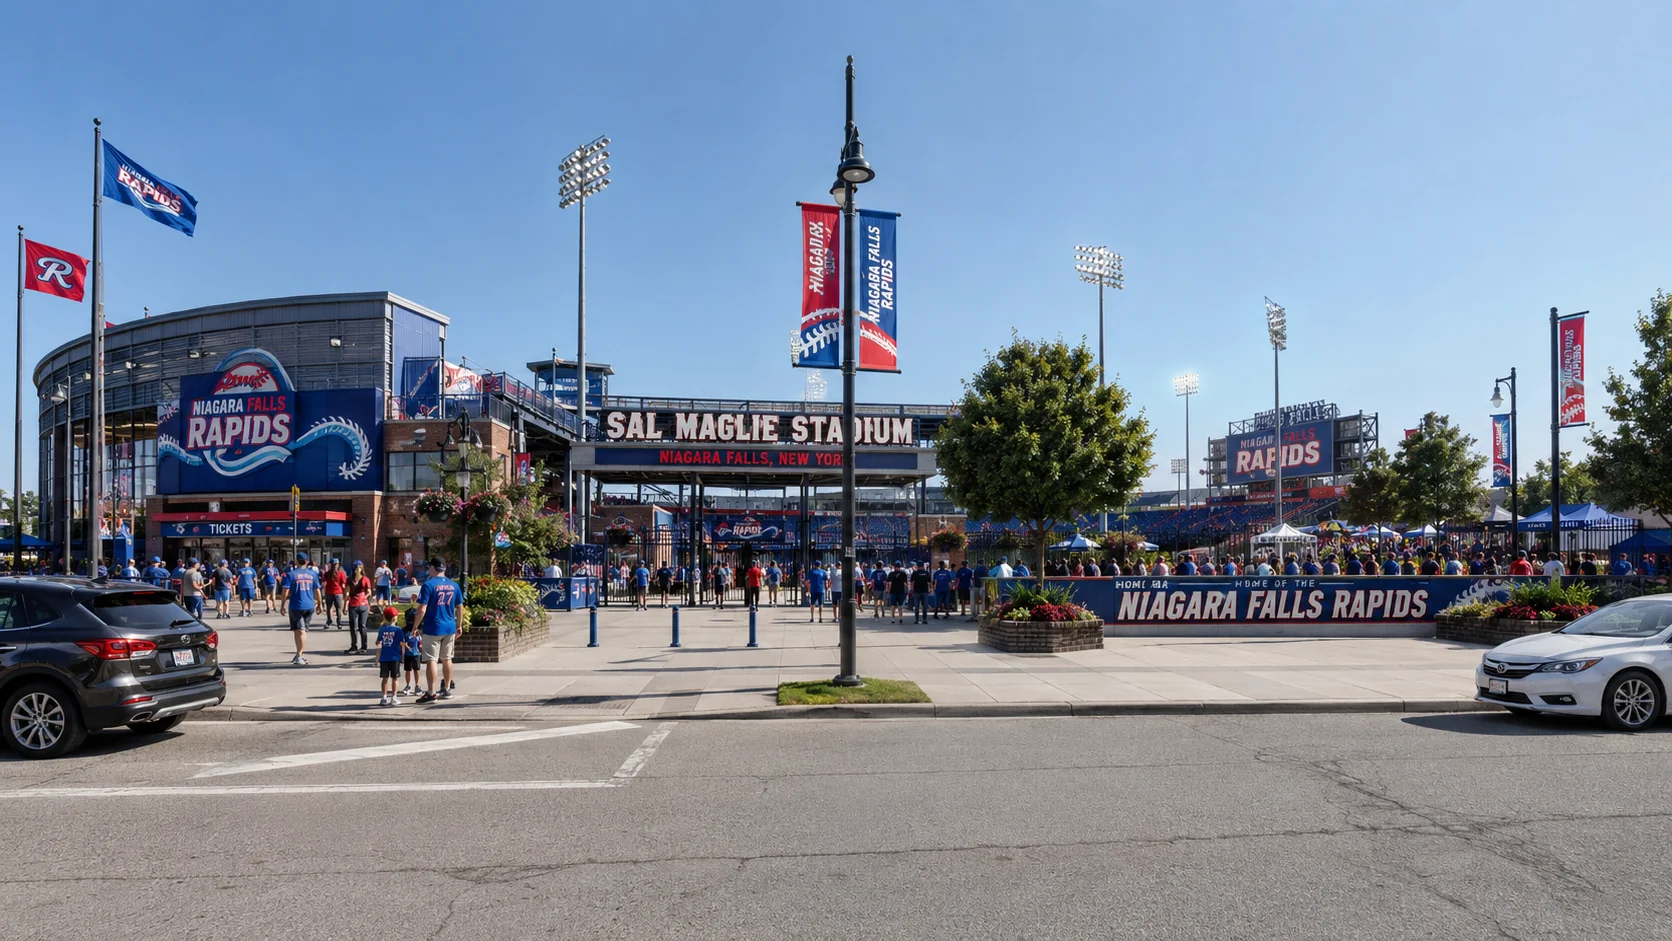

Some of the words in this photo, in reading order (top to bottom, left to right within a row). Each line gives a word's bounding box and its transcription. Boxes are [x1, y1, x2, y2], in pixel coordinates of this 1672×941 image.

[118, 166, 182, 213] RAPIDS
[868, 225, 880, 263] FALLS
[37, 256, 74, 289] R
[881, 259, 893, 310] RAPIDS
[193, 398, 244, 416] NIAGARA
[247, 395, 286, 412] FALLS
[187, 412, 291, 449] RAPIDS
[606, 411, 662, 440] SAL
[675, 412, 779, 443] MAGLIE
[1284, 428, 1316, 441] FALLS
[659, 450, 719, 464] NIAGARA
[726, 451, 774, 467] FALLS,
[779, 453, 810, 465] NEW
[815, 453, 844, 466] YOR
[1235, 440, 1321, 474] RAPIDS
[209, 523, 252, 535] TICKETS
[437, 592, 454, 606] 27
[1117, 590, 1238, 621] NIAGARA
[1246, 589, 1325, 620] FALLS
[1331, 589, 1429, 619] RAPIDS
